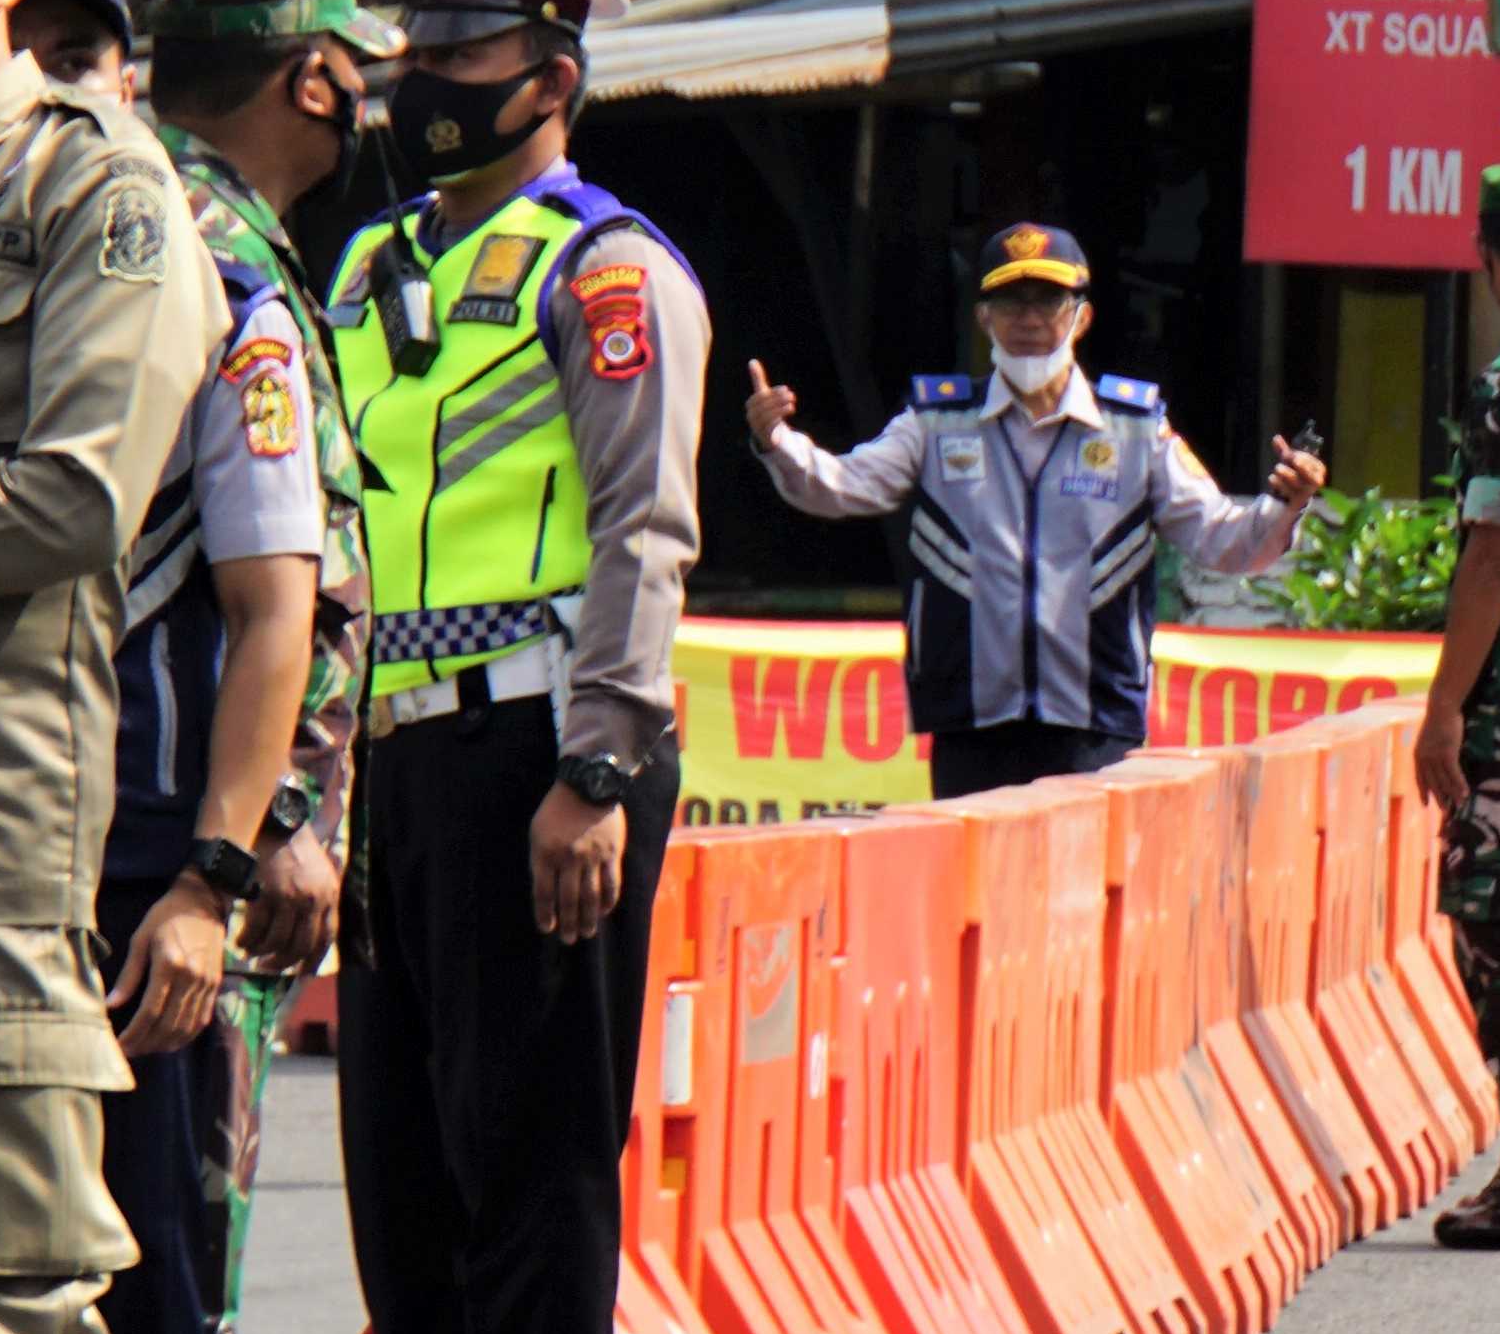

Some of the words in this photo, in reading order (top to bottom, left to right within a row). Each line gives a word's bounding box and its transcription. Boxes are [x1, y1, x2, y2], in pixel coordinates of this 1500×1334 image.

[1324, 11, 1373, 52] XT
[1344, 144, 1368, 213] 1
[1388, 146, 1463, 217] KM
